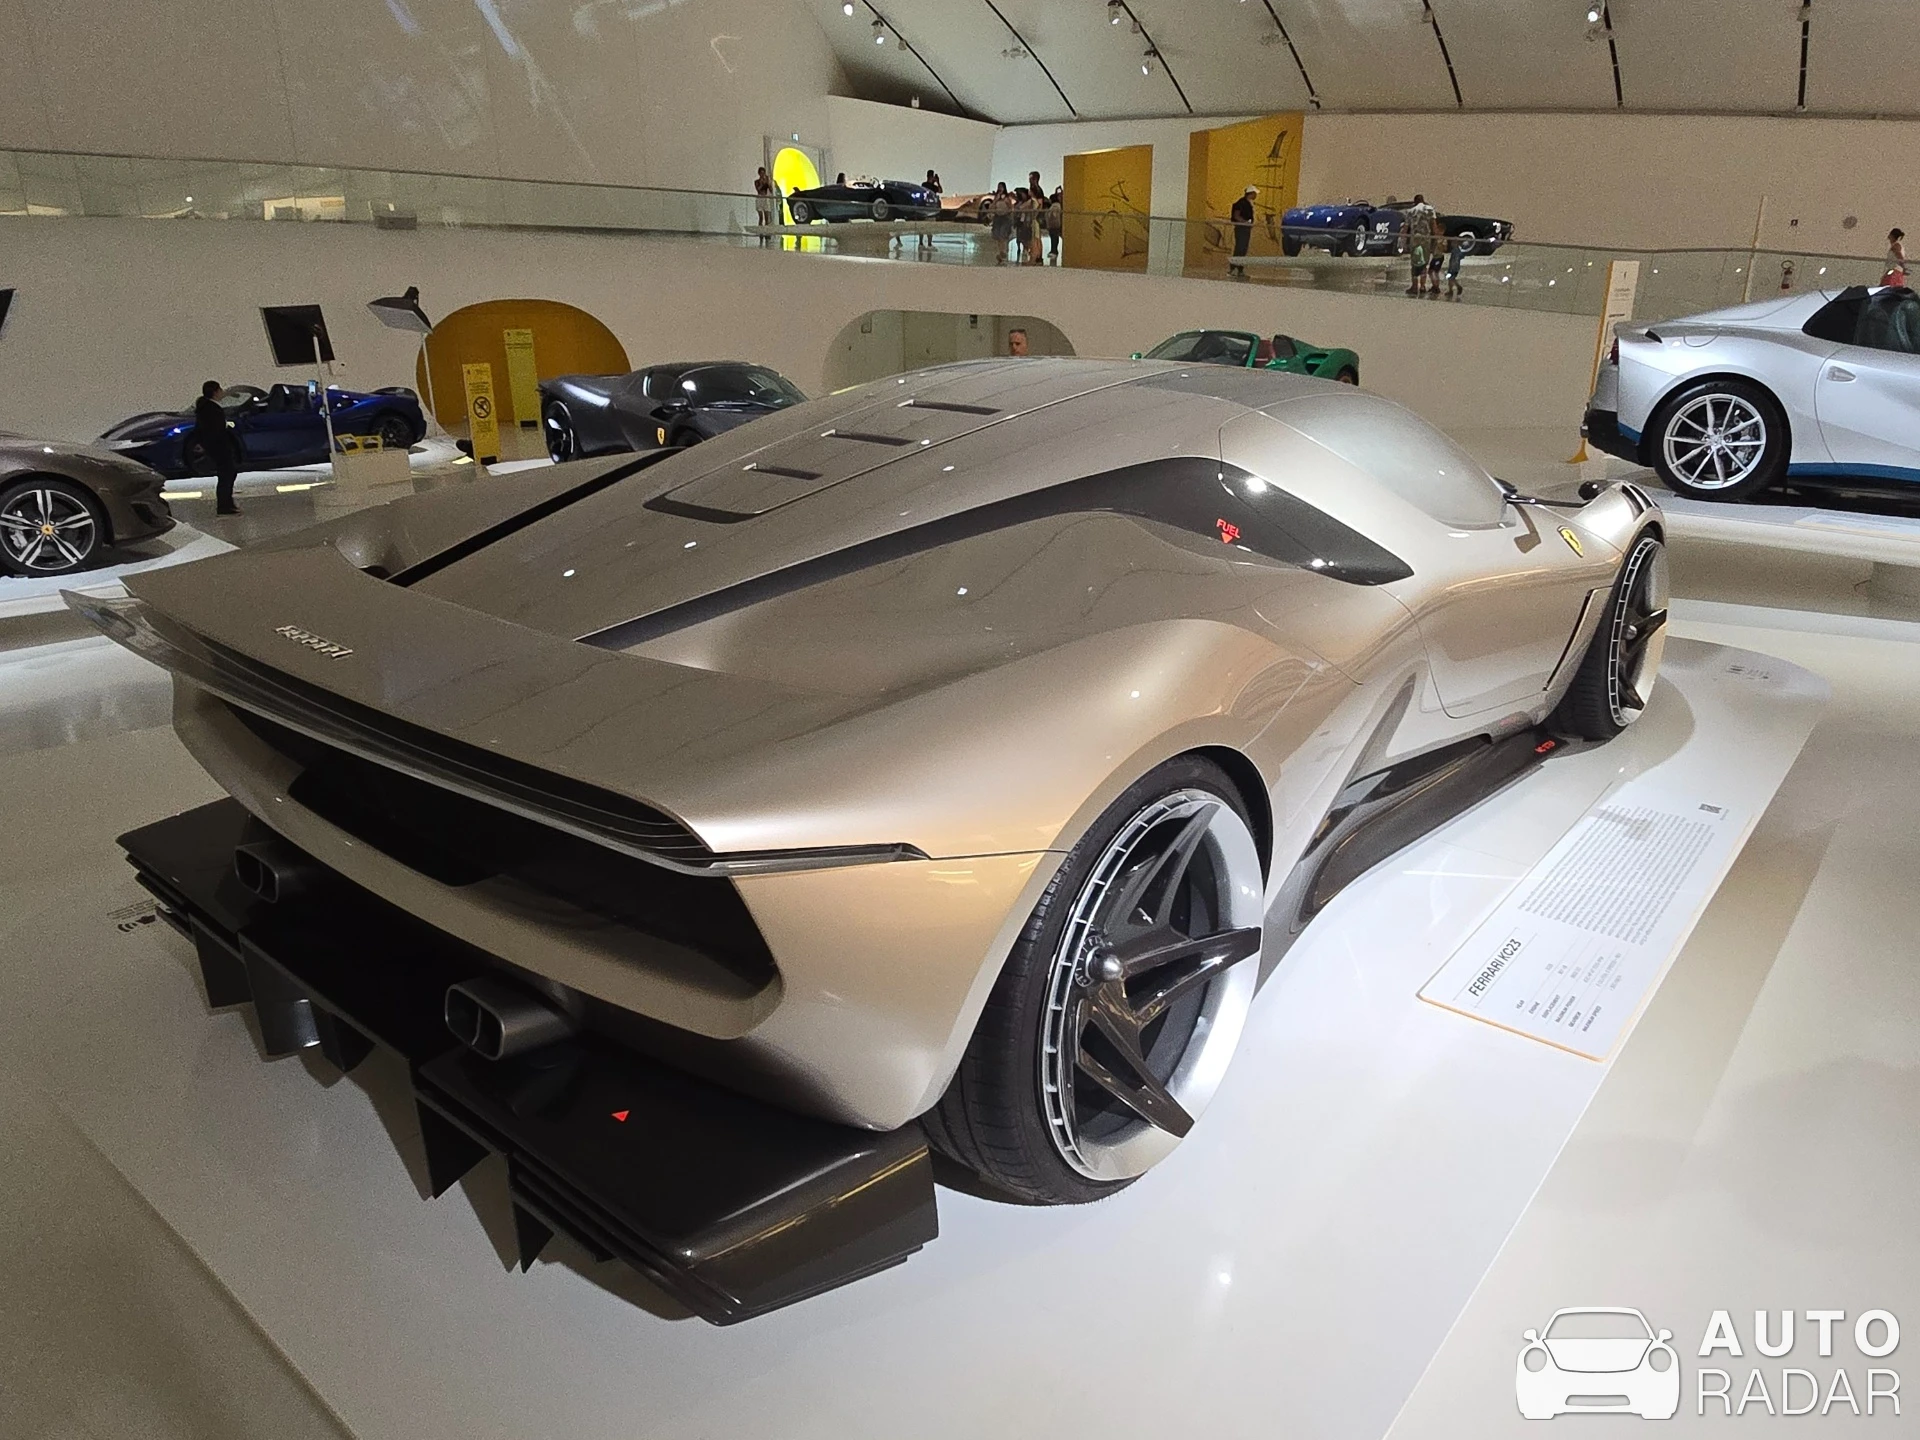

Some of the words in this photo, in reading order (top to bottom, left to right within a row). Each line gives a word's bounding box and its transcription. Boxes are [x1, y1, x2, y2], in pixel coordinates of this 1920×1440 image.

[1216, 519, 1240, 538] FUEL
[1468, 958, 1505, 997] FERRARI
[1497, 938, 1521, 962] KC23
